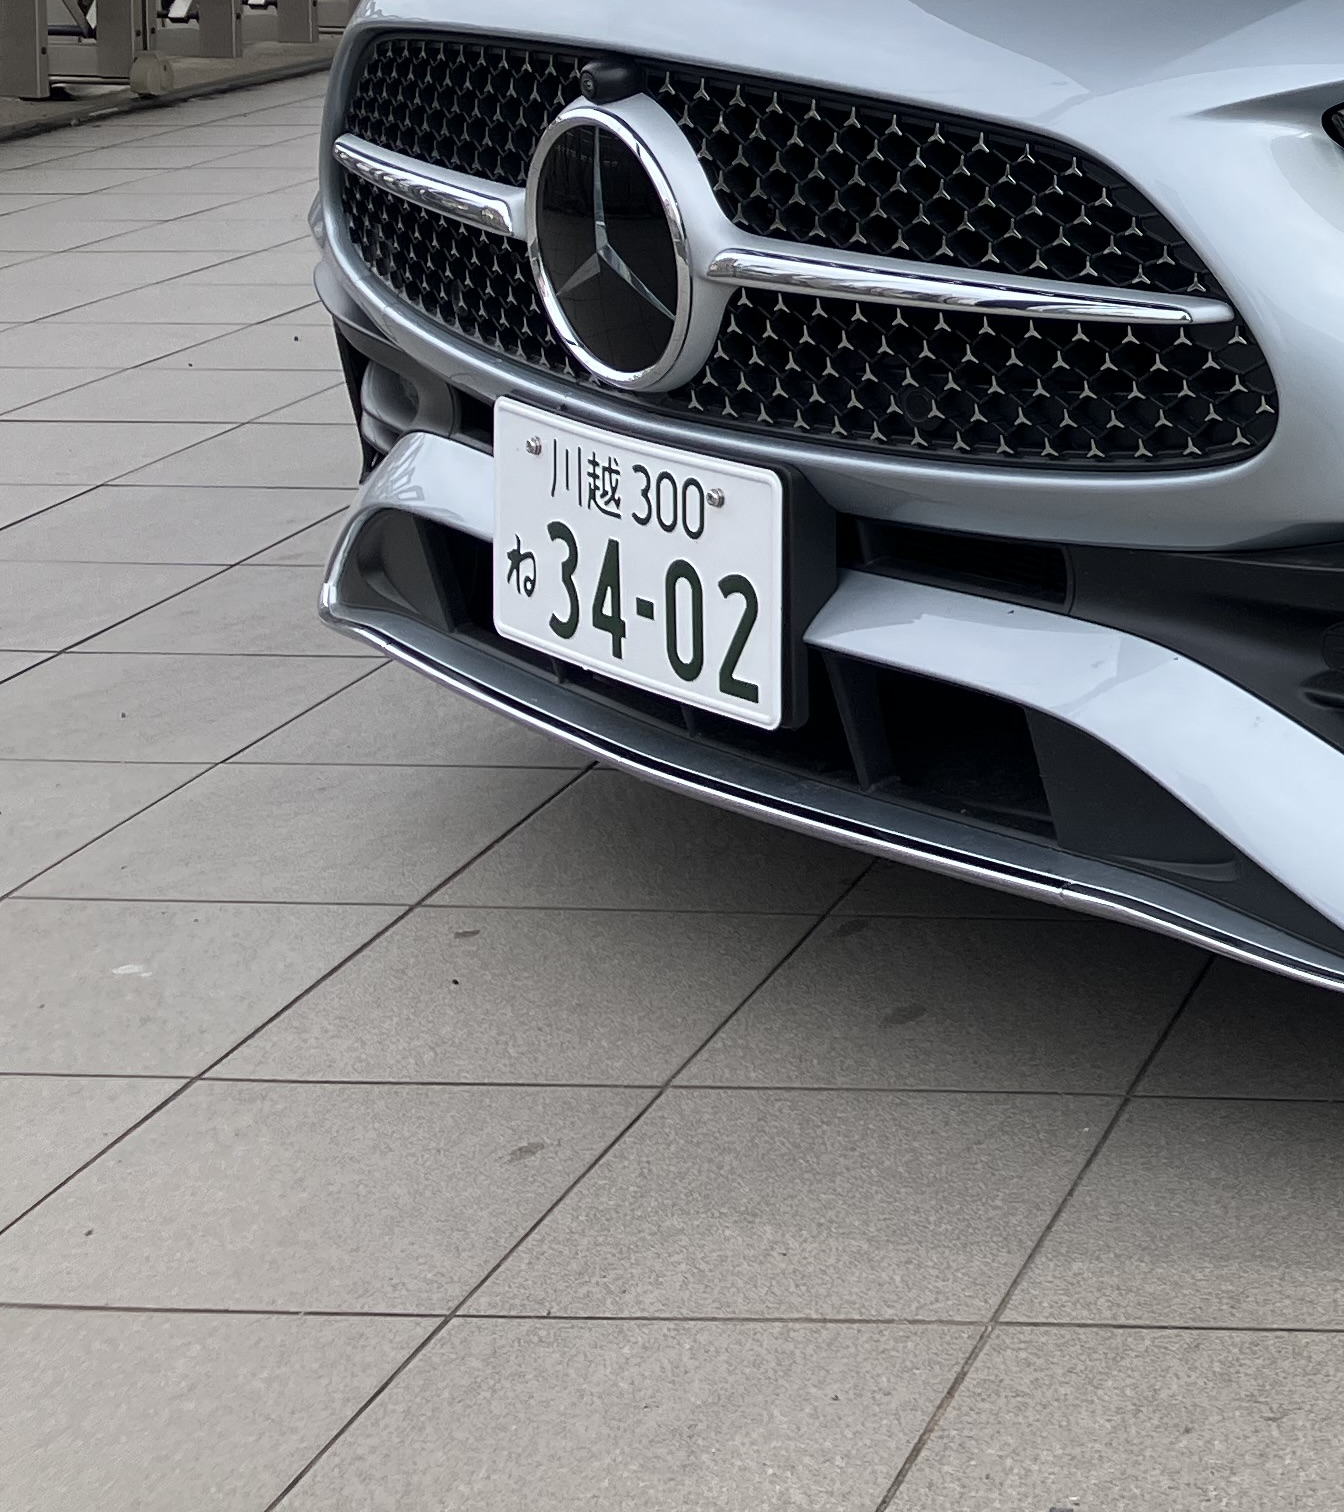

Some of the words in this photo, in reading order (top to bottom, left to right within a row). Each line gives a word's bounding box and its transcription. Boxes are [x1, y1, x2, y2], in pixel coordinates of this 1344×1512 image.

[551, 438, 622, 520] 川越
[631, 463, 706, 540] 300
[506, 534, 538, 598] ね
[546, 520, 760, 704] 34-02
